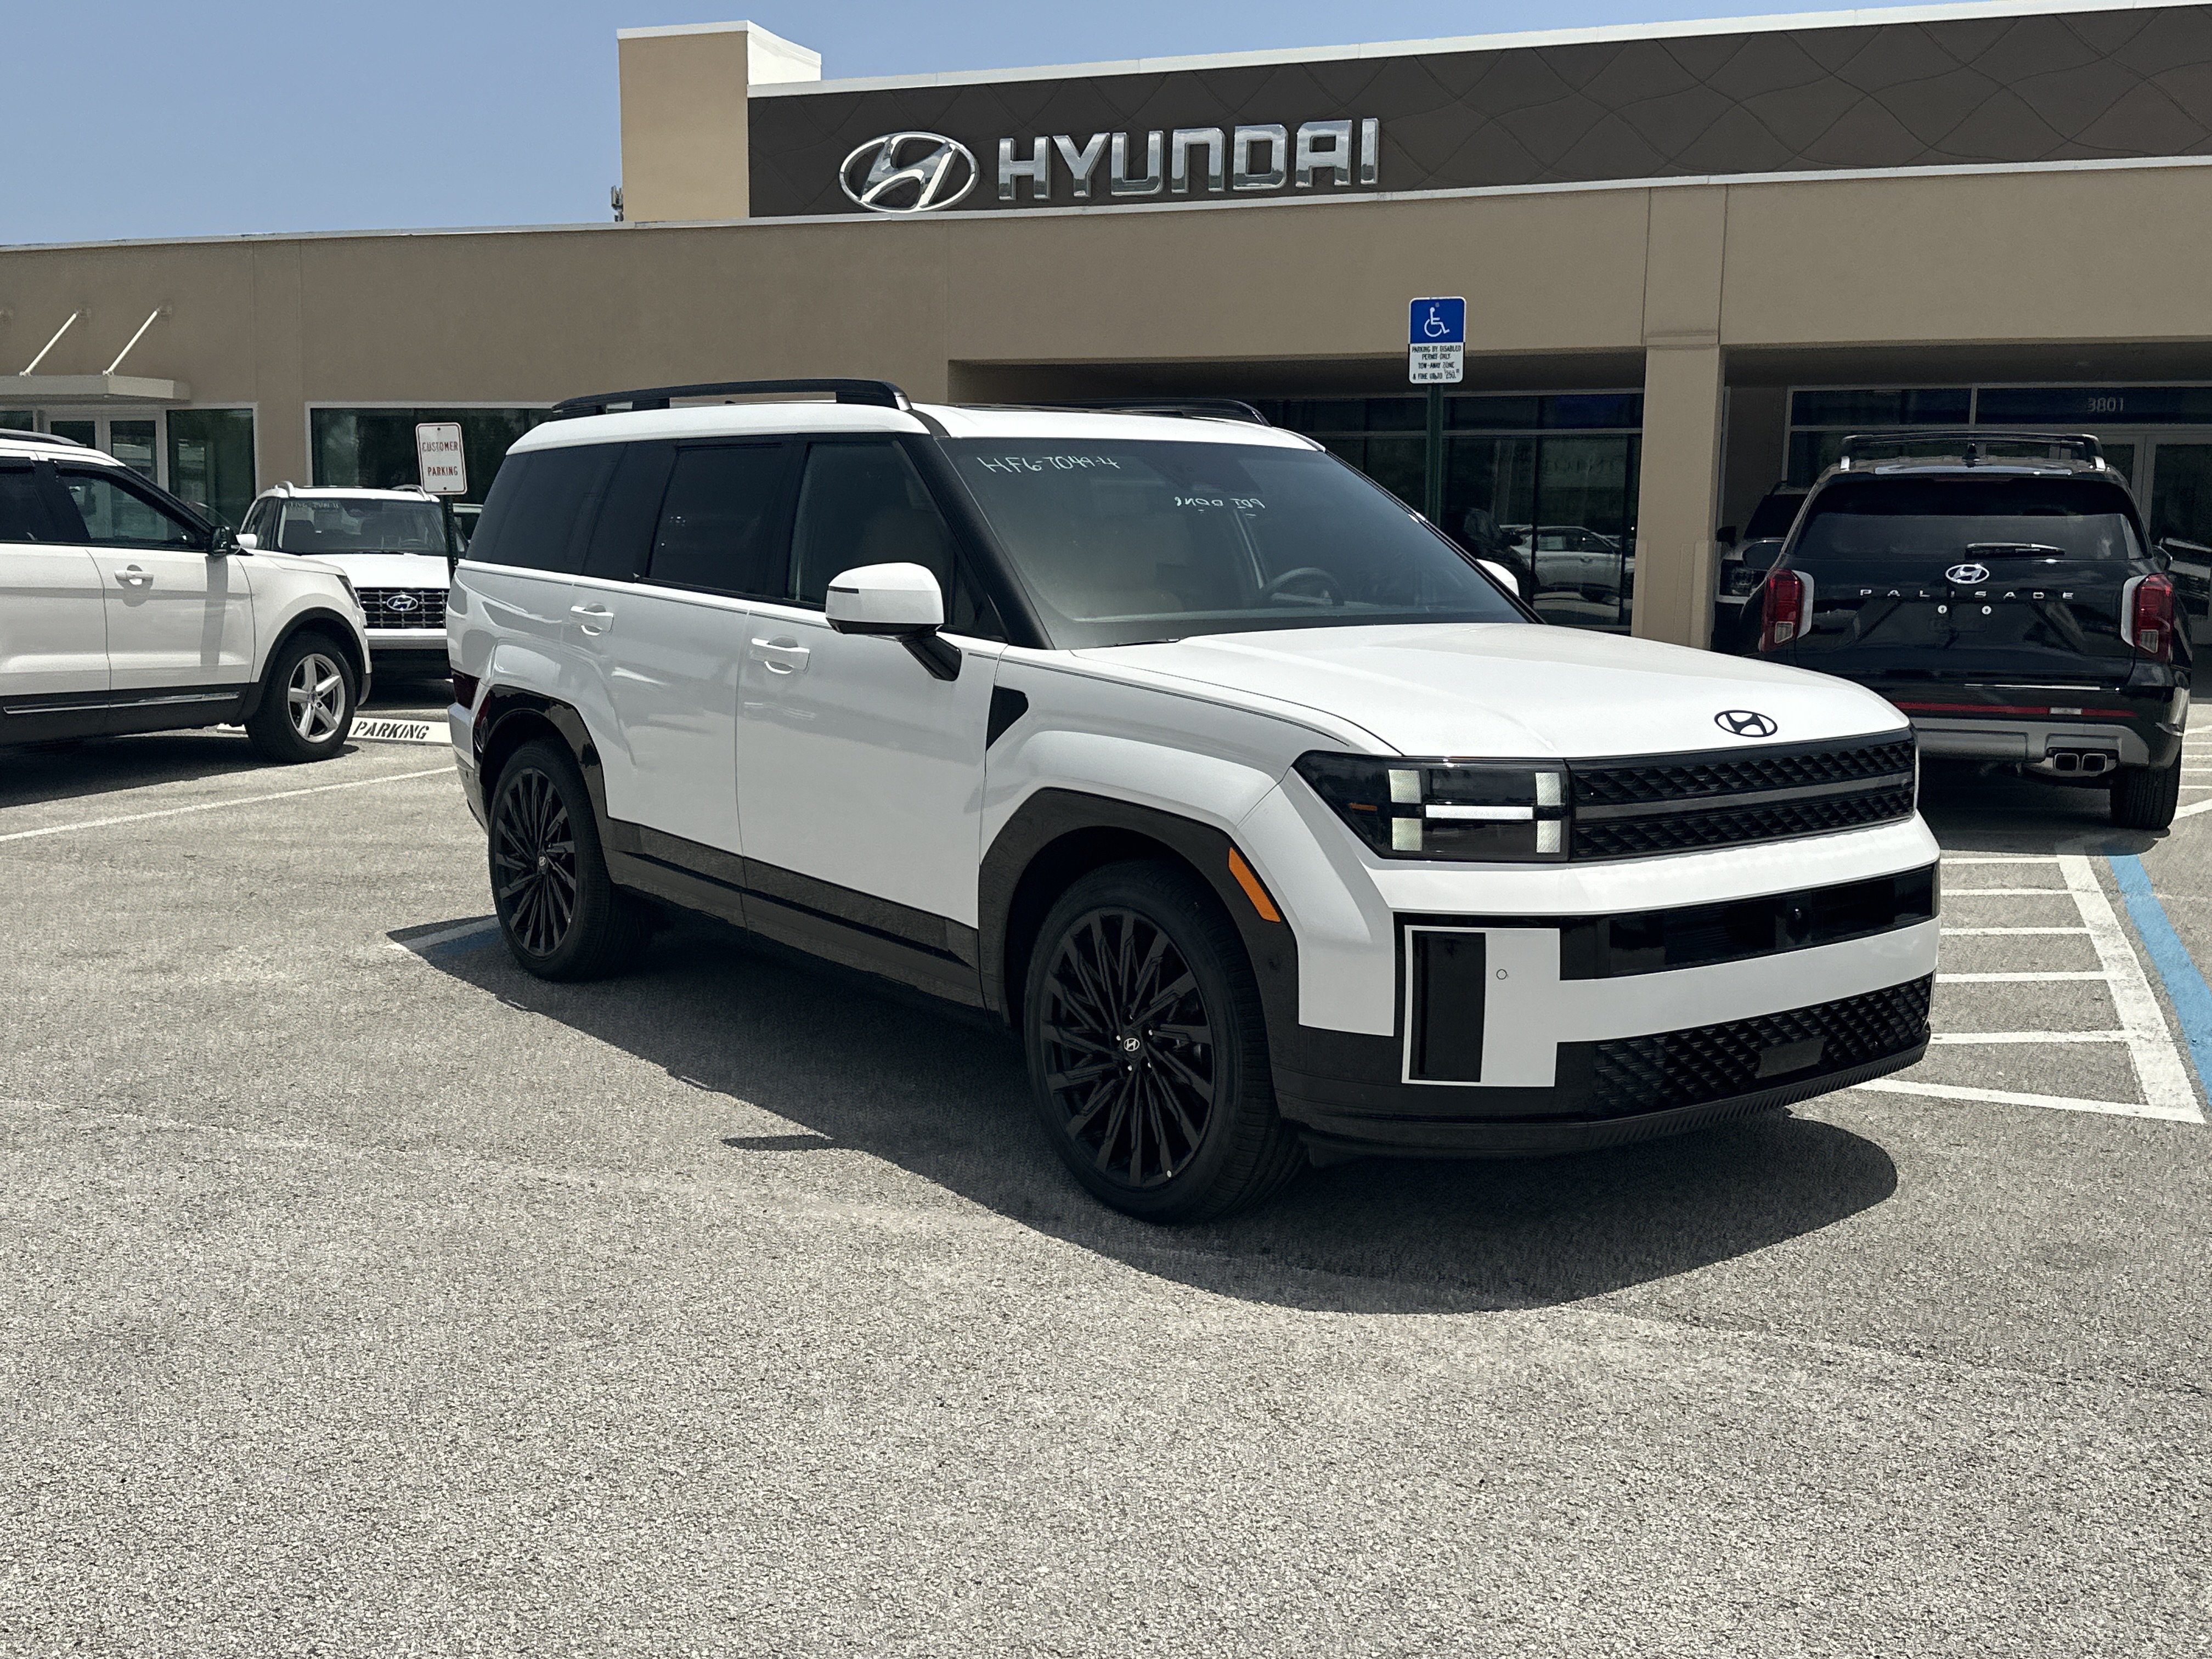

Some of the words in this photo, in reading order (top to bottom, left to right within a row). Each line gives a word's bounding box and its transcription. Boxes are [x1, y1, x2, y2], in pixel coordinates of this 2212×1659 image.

[997, 117, 1380, 201] HYUNDAI
[2087, 397, 2124, 413] 3801
[421, 441, 458, 452] CUSTOMER
[427, 466, 458, 476] PARKING
[1860, 589, 2074, 600] PALISADE
[352, 721, 430, 740] PARKING
